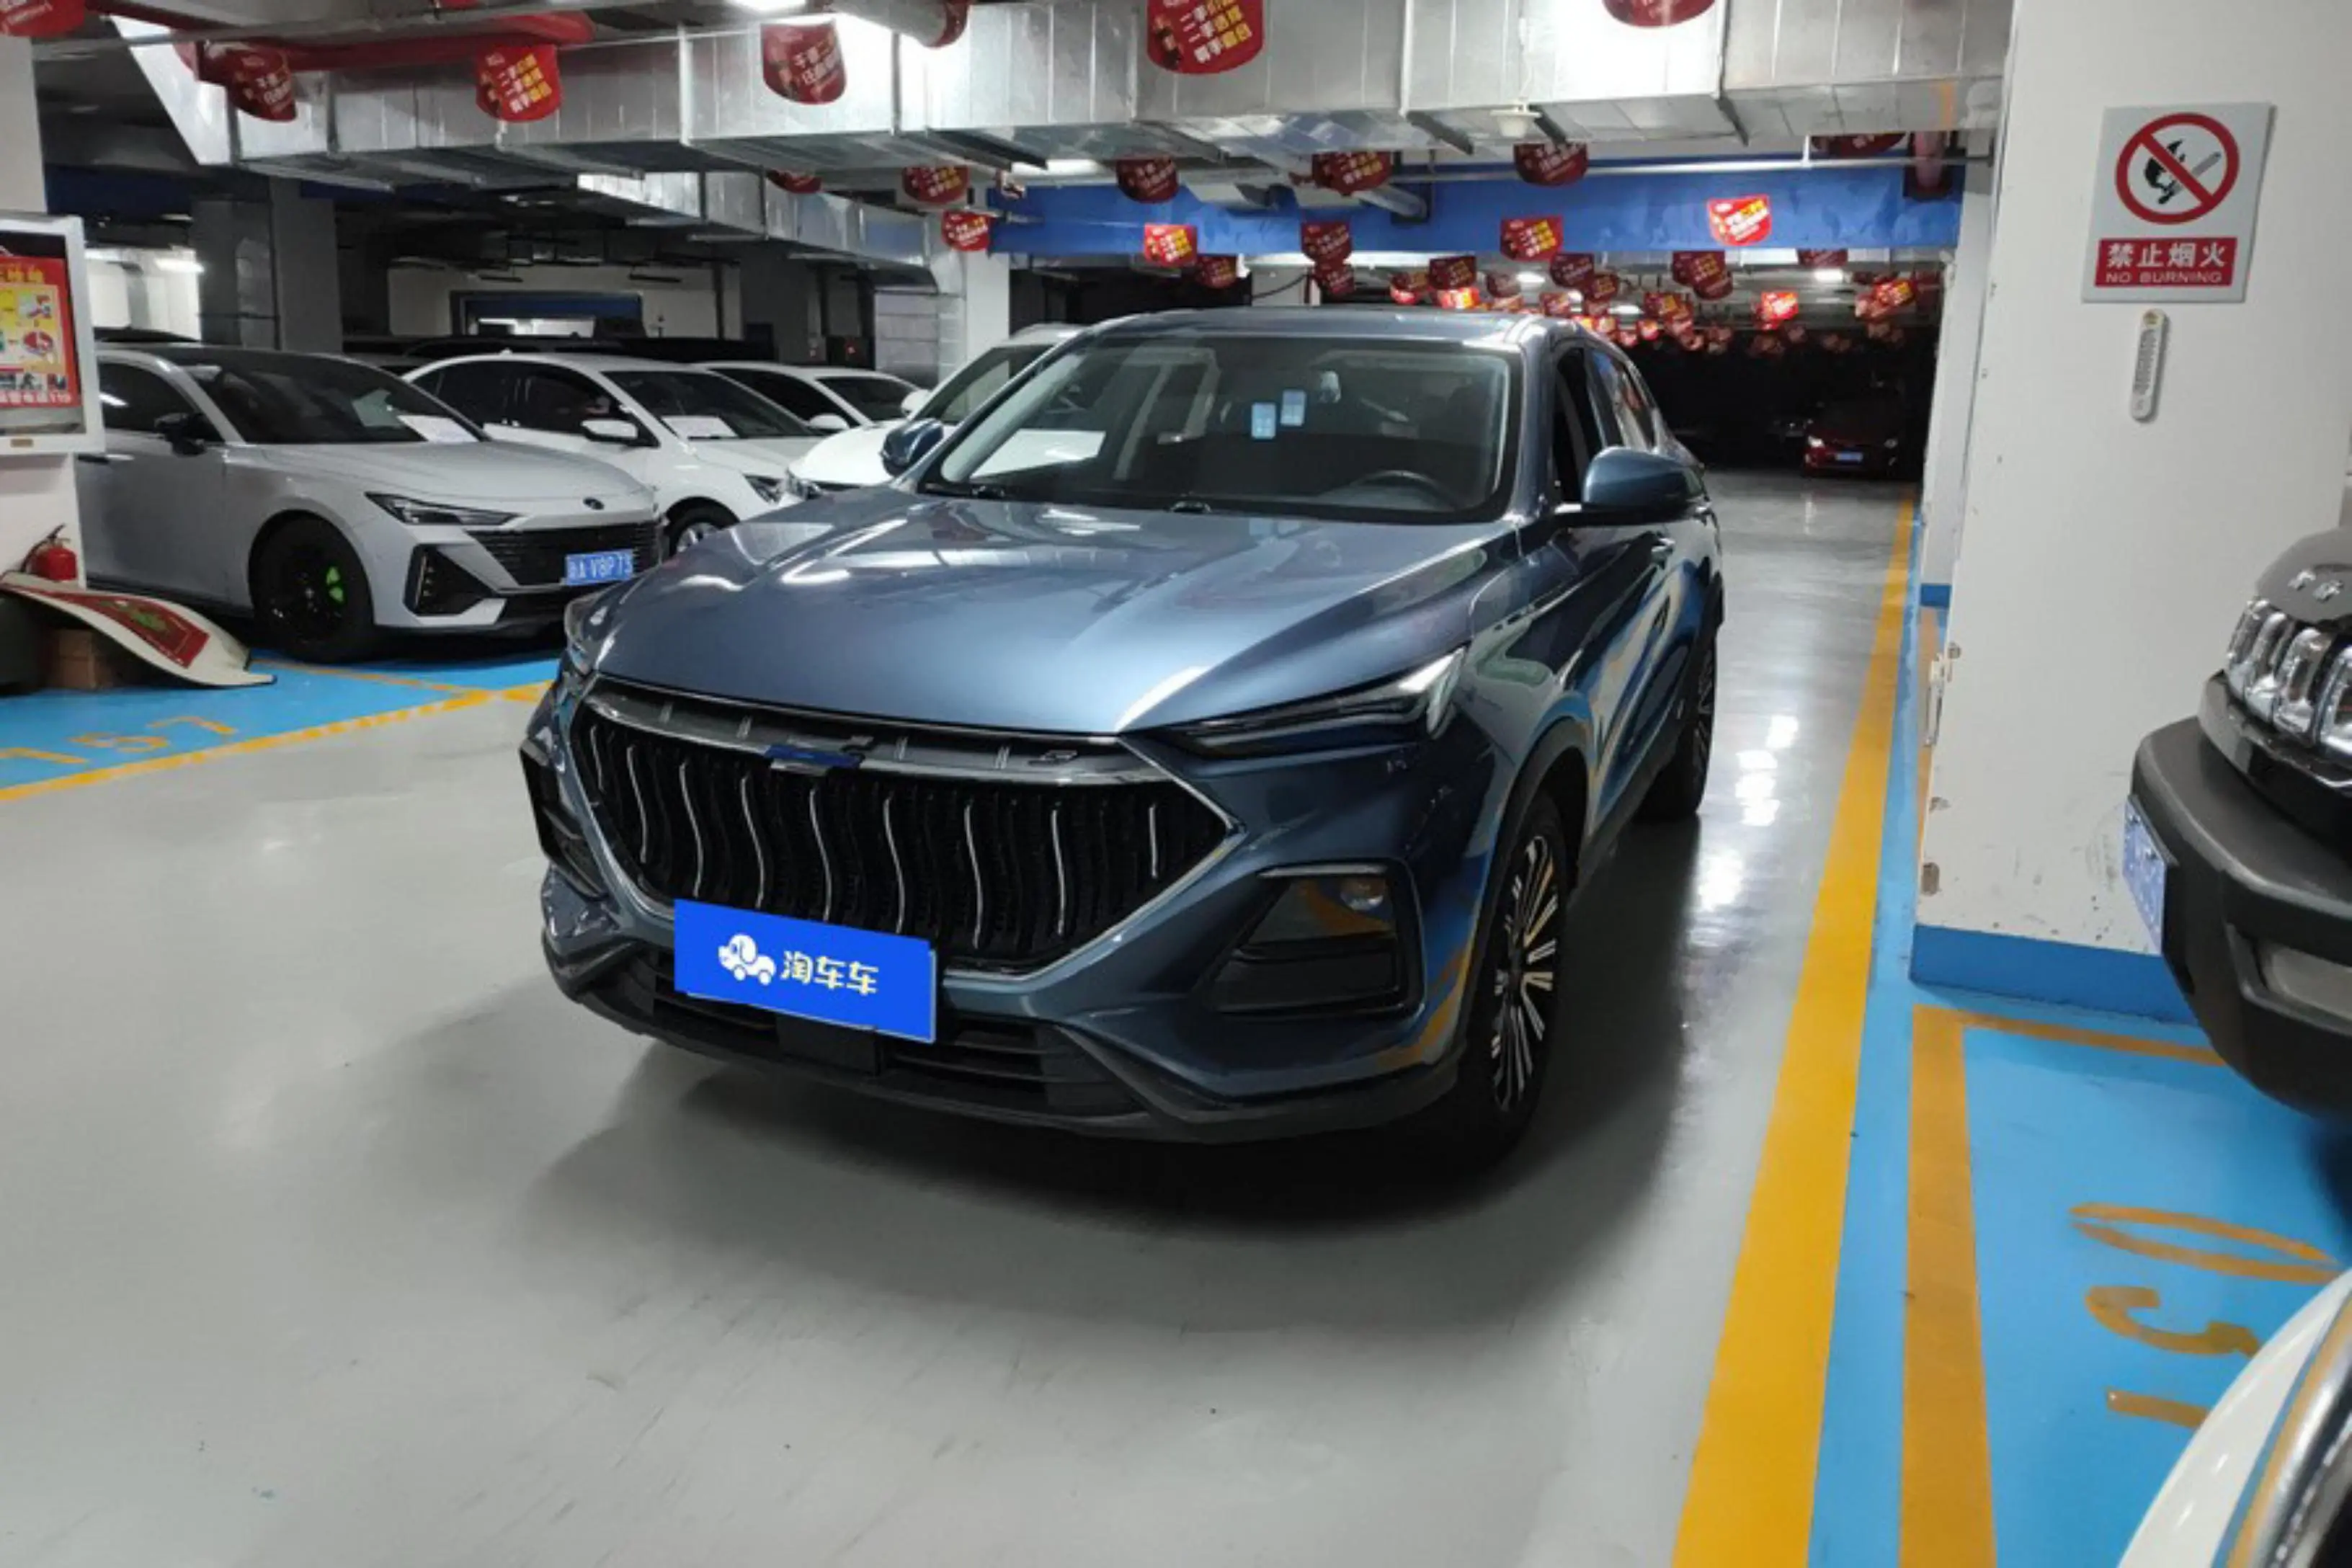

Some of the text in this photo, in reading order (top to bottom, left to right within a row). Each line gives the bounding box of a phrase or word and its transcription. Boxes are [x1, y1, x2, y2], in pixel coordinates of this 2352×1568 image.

[2106, 242, 2226, 269] 禁止烟火
[2106, 271, 2222, 283] NO BURNING
